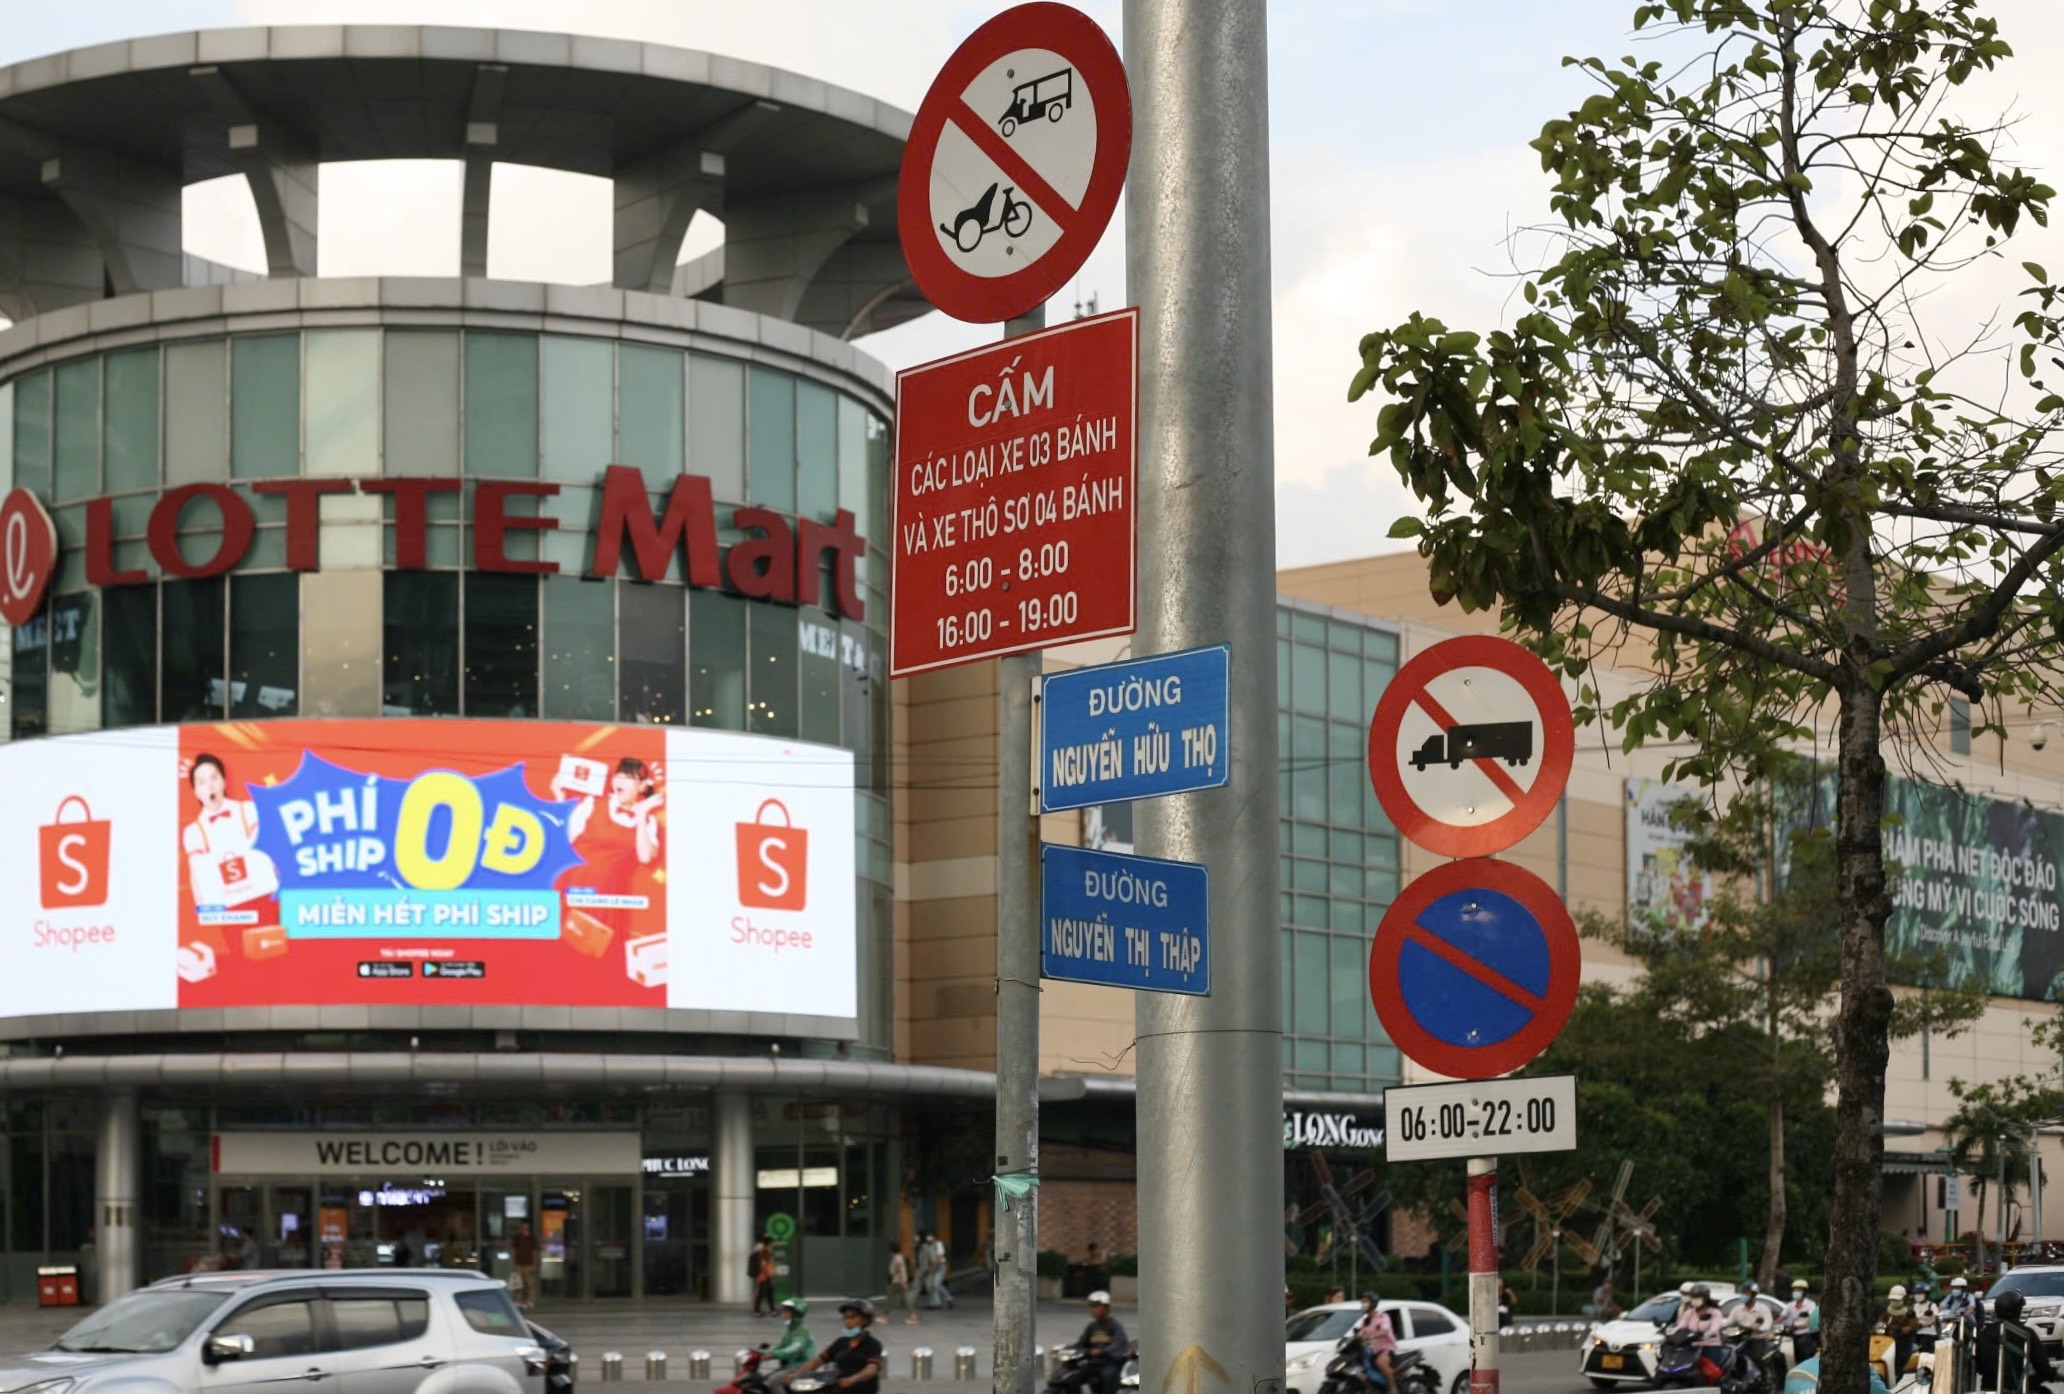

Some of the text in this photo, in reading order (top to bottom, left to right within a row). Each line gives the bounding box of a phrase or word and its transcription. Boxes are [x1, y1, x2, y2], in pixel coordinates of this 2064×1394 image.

[968, 355, 1055, 428] CẤM
[911, 414, 1116, 496] CÁC LOẠI XE 03 BÁNH
[85, 464, 866, 622] LOTTE Mart
[904, 472, 1123, 556] VÀ XE THÔ SƠ 04 BÁNH
[945, 556, 992, 597] 6:00
[1018, 540, 1069, 581] 8:00
[936, 607, 992, 650] 16:00
[1018, 591, 1078, 633] 19:00
[1088, 675, 1182, 717] ĐƯỜNG
[1052, 721, 1217, 788] NGUYỄN HỮU THỌ
[278, 772, 378, 846] PHÍ
[295, 836, 386, 877] SHIP
[1880, 826, 1920, 867] HÁM
[2024, 853, 2056, 892] ĐÁO
[433, 896, 479, 926] PHÍ
[486, 902, 549, 927] SHIP
[1084, 868, 1168, 908] ĐƯỜNG
[1927, 877, 1953, 913] MỸ
[1954, 886, 1972, 926] VỊ
[1974, 888, 2017, 931] CUỘC
[2018, 892, 2060, 932] SỐNG
[34, 920, 116, 954] Shopee
[731, 916, 813, 953] Shopee
[1051, 911, 1201, 982] NGUYỄN THỊ THẬP
[1293, 1112, 1356, 1146] LONG
